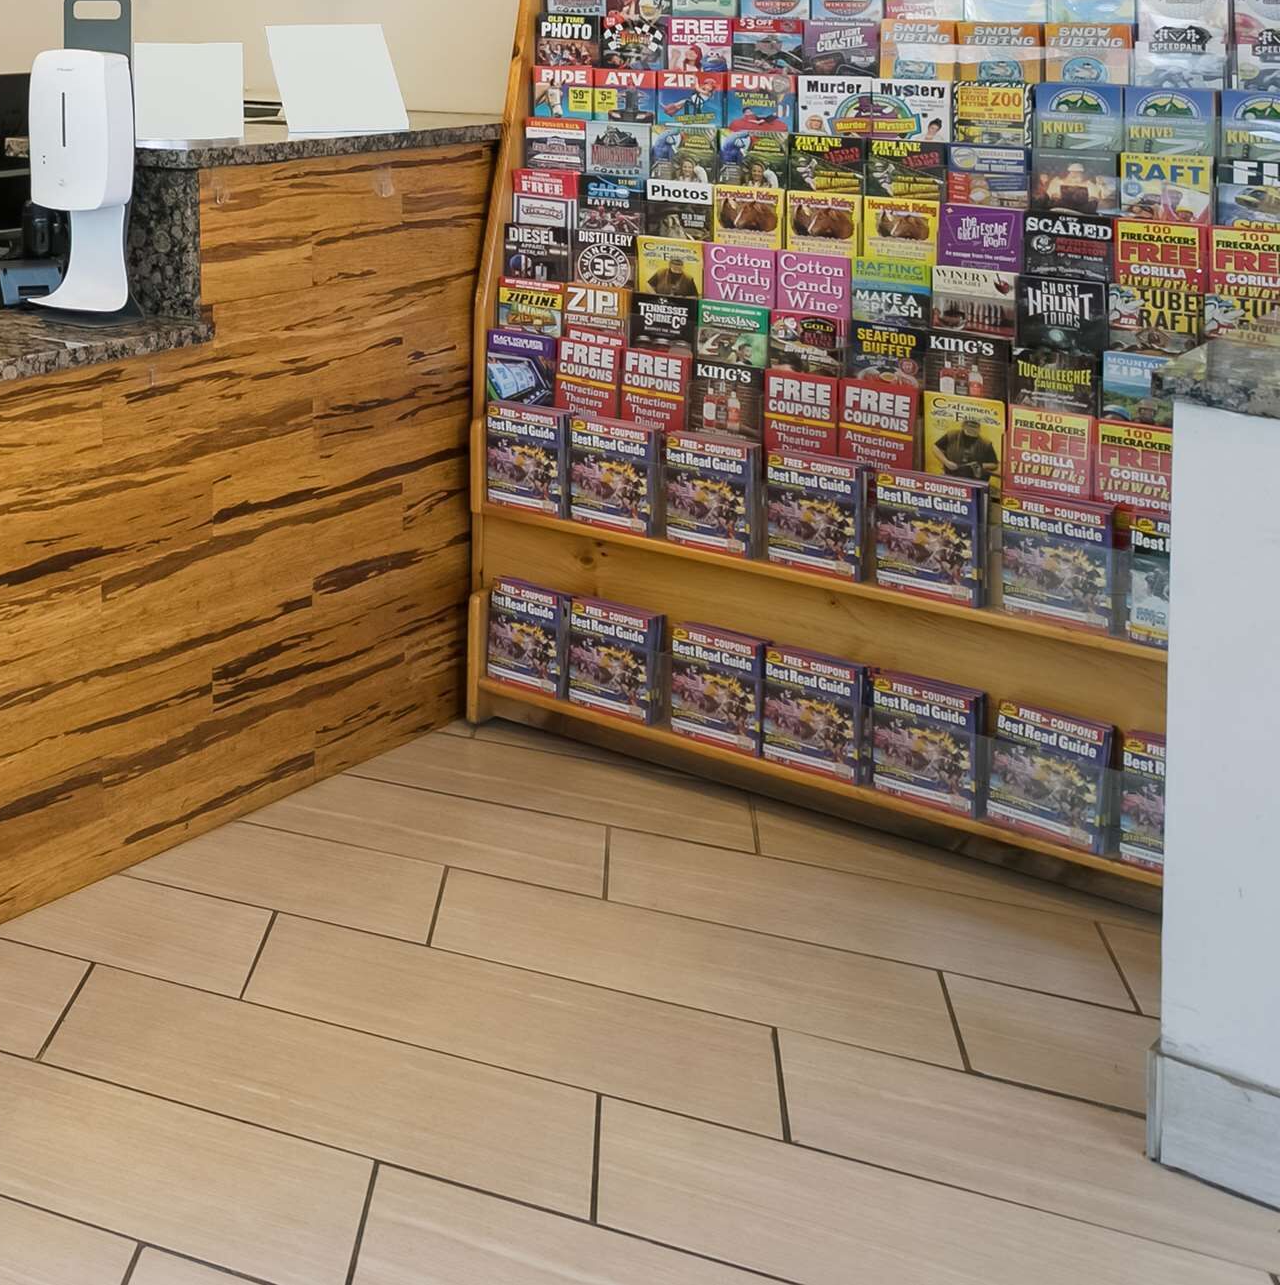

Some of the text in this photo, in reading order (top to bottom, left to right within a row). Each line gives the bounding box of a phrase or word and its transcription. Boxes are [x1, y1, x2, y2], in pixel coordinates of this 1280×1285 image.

[547, 16, 563, 24] OLD
[671, 19, 729, 35] FREE
[894, 23, 939, 33] SNOW
[541, 22, 592, 40] PHOTO
[671, 33, 727, 44] cupcake
[974, 27, 1024, 36] SNOW
[1059, 27, 1111, 38] SNOW
[964, 35, 1035, 46] TUBING
[1048, 37, 1123, 47] TUBING
[1150, 43, 1205, 53] SPEEDPARK
[541, 70, 587, 84] RIDE
[605, 71, 645, 86] ATV
[663, 74, 698, 87] ZIP
[730, 75, 773, 89] FUN
[807, 80, 862, 94] Murder
[990, 92, 1022, 107] ZOO
[796, 136, 842, 148] ZIPLINE
[871, 140, 922, 152] ZIPLINE
[1125, 162, 1205, 185] RAFT
[521, 180, 563, 196] FREE
[651, 184, 709, 201] Photos
[587, 198, 630, 209] RAFTING
[789, 192, 855, 209] Horseback Riding
[868, 201, 937, 216] Horseback Riding
[509, 227, 558, 244] DIESEL
[1025, 216, 1113, 240] SCARED
[1143, 224, 1171, 234] 100
[578, 231, 633, 247] DISTILLERY
[1121, 231, 1196, 246] FIRECRACKERS
[1239, 232, 1270, 243] 100
[710, 246, 771, 269] Cotton
[1119, 240, 1199, 268] FREE
[592, 259, 615, 276] 35
[780, 253, 844, 277] Cotton
[856, 260, 922, 275] RAFTING
[1130, 264, 1186, 279] GORILLA
[711, 266, 770, 289] Candy
[936, 268, 988, 283] WINERY
[717, 284, 766, 304] Wine
[780, 273, 843, 299] Candy
[1041, 281, 1079, 297] GHOST
[507, 292, 557, 308] ZIPLINE
[786, 291, 839, 312] Wine
[856, 290, 918, 306] MAKE A
[1027, 287, 1094, 321] HAUNT
[638, 302, 689, 317] TENNESSEE
[861, 301, 922, 318] SPLASH
[803, 322, 834, 333] GOLD
[1042, 312, 1081, 328] TOURS
[1139, 309, 1197, 334] RAFT
[857, 327, 917, 347] SEAFOOD
[930, 335, 995, 356] KING'S
[560, 340, 615, 369] FREE
[863, 341, 912, 358] BUFFET
[559, 363, 613, 382] COUPONS
[625, 351, 682, 380] FREE
[697, 364, 752, 384] KING'S
[1017, 359, 1092, 386] TUCKALEECHEE
[560, 381, 609, 399] Attractions
[624, 373, 680, 393] COUPONS
[769, 377, 832, 406] FREE
[565, 391, 603, 408] Theaters
[625, 393, 677, 410] Attractions
[845, 385, 911, 418] FREE
[932, 397, 998, 416] Craftsmen's
[630, 404, 670, 420] Theaters
[768, 400, 830, 421] COUPONS
[1034, 413, 1063, 424] 100
[634, 415, 665, 431] Dining
[770, 421, 828, 439] Attractions
[844, 410, 909, 432] COUPONS
[1014, 418, 1086, 437] FIRECRACKERS
[587, 421, 645, 441] FREE COUPONS
[1124, 428, 1153, 440] 100
[572, 431, 646, 457] Best Read Guide
[776, 433, 821, 448] Theaters
[845, 431, 905, 450] Attractions
[1012, 428, 1087, 460] FREE
[851, 443, 897, 461] Theaters
[1021, 451, 1075, 469] GORILLA
[784, 457, 851, 477] FREE COUPONS
[768, 467, 851, 494] Best Read Guide
[1014, 475, 1081, 495] SUPERSTORE
[1110, 467, 1167, 486] GORILLA
[895, 476, 967, 497] FREE COUPONS
[877, 487, 969, 515] Best Read Guide
[1023, 500, 1101, 525] FREE COUPONS
[1002, 510, 1102, 542] Best Read Guide
[689, 632, 752, 655] FREE COUPONS
[673, 640, 752, 672] Best Read Guide
[783, 654, 851, 679] FREE COUPONS
[766, 660, 851, 697] Best Read Guide
[892, 682, 965, 708] FREE COUPONS
[874, 691, 966, 726] Best Read Guide
[1123, 751, 1154, 772] Best
